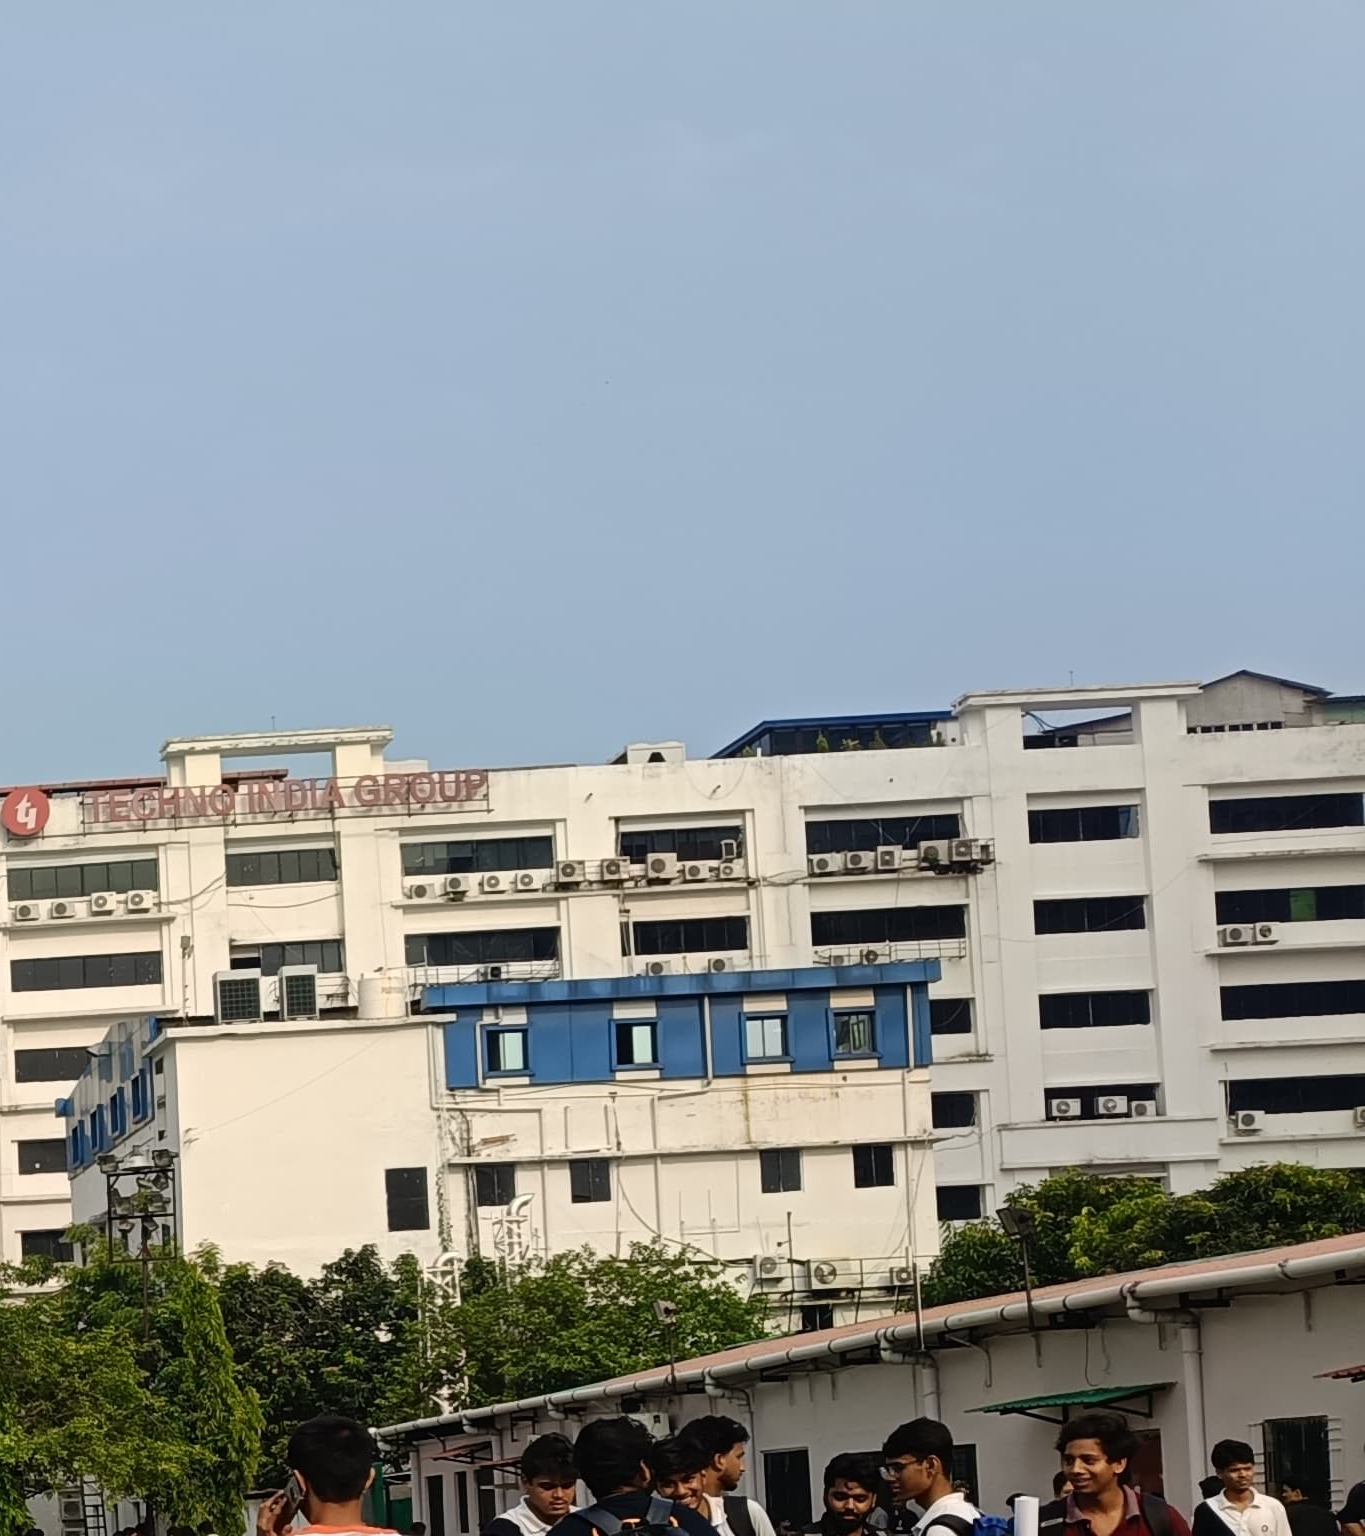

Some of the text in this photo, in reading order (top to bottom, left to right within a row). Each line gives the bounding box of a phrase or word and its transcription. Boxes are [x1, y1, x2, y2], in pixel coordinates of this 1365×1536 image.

[84, 769, 488, 823] TECHNO INDIA GROUP
